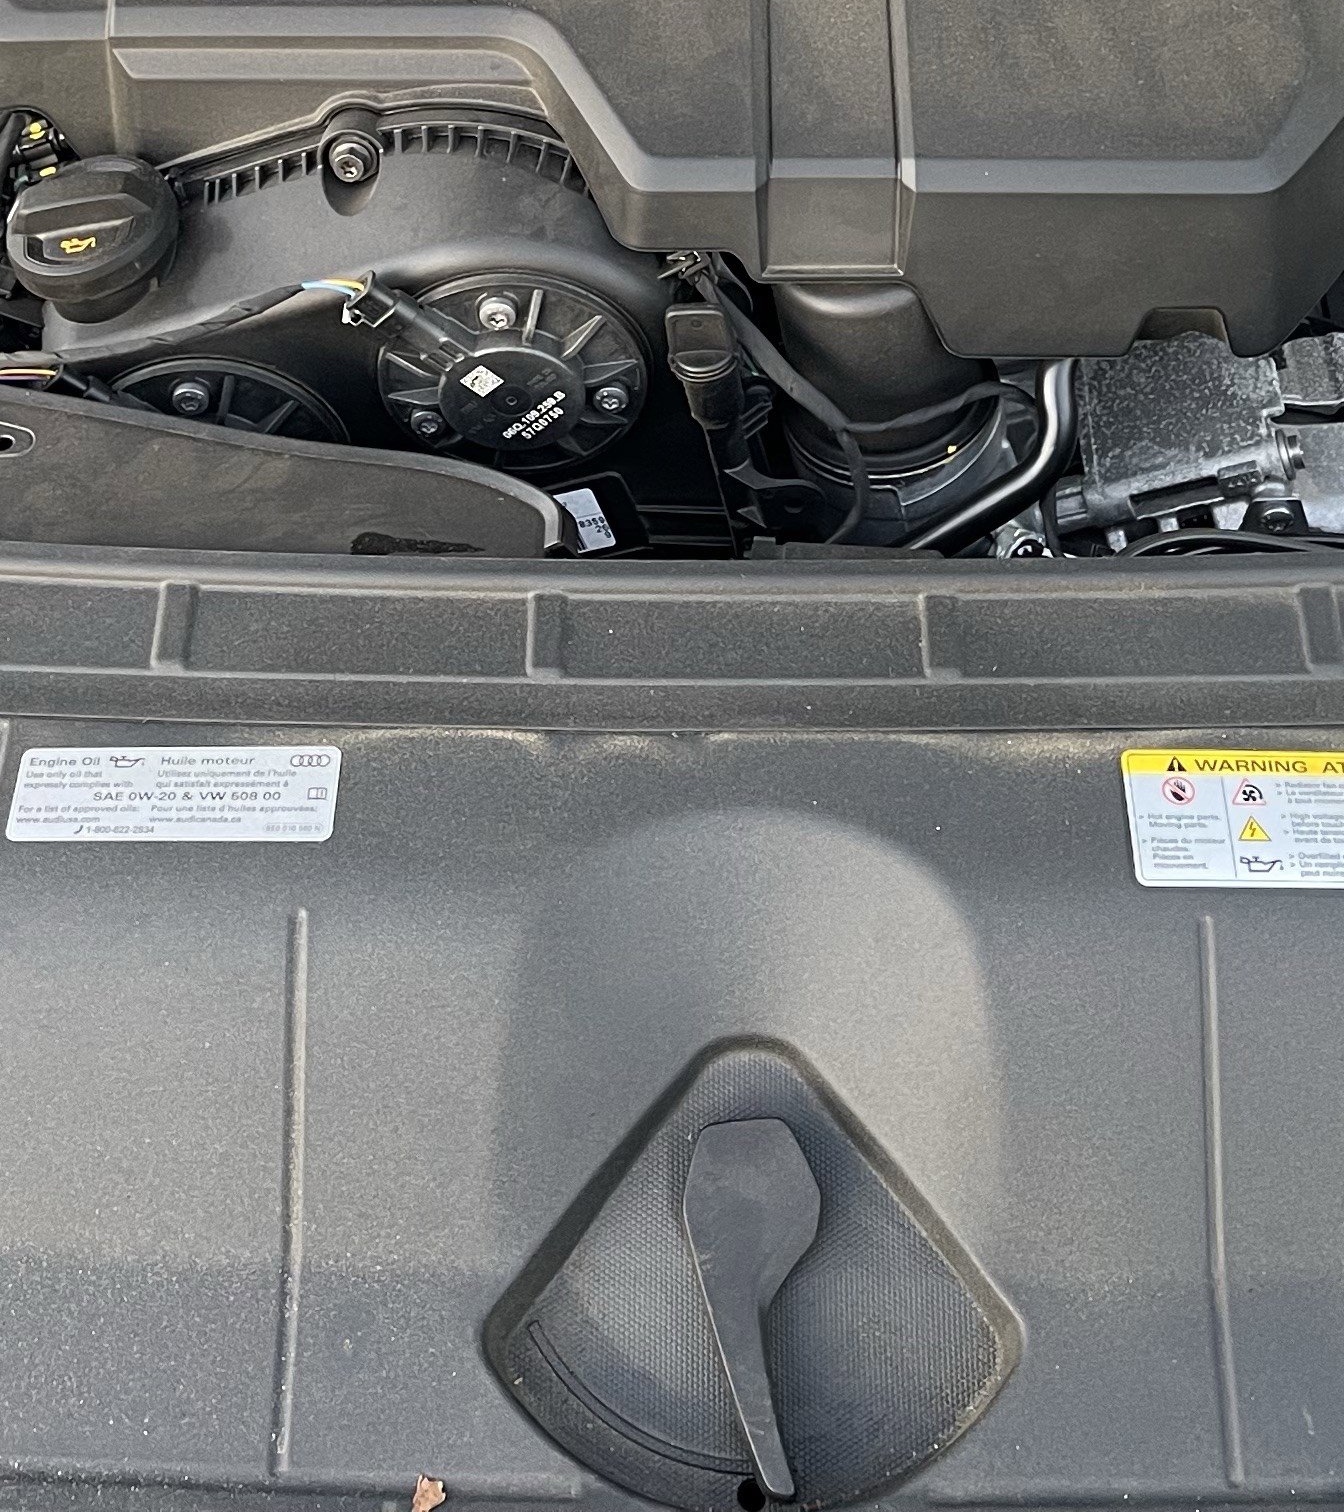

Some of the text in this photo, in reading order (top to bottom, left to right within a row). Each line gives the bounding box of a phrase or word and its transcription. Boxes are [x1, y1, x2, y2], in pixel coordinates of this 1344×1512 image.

[30, 756, 256, 768] Engine Oil Huile moteur
[1194, 758, 1308, 774] WARNING
[26, 770, 45, 778] Use
[47, 770, 67, 779] only
[84, 770, 103, 778] that
[253, 769, 266, 778] de
[156, 780, 171, 789] qui
[93, 791, 124, 801] SAE
[128, 791, 176, 801] 0W-20
[182, 791, 193, 801] &
[199, 791, 227, 801] VW
[263, 791, 282, 801] 00
[18, 805, 34, 813] For
[60, 805, 71, 813] of
[151, 804, 174, 812] Pour
